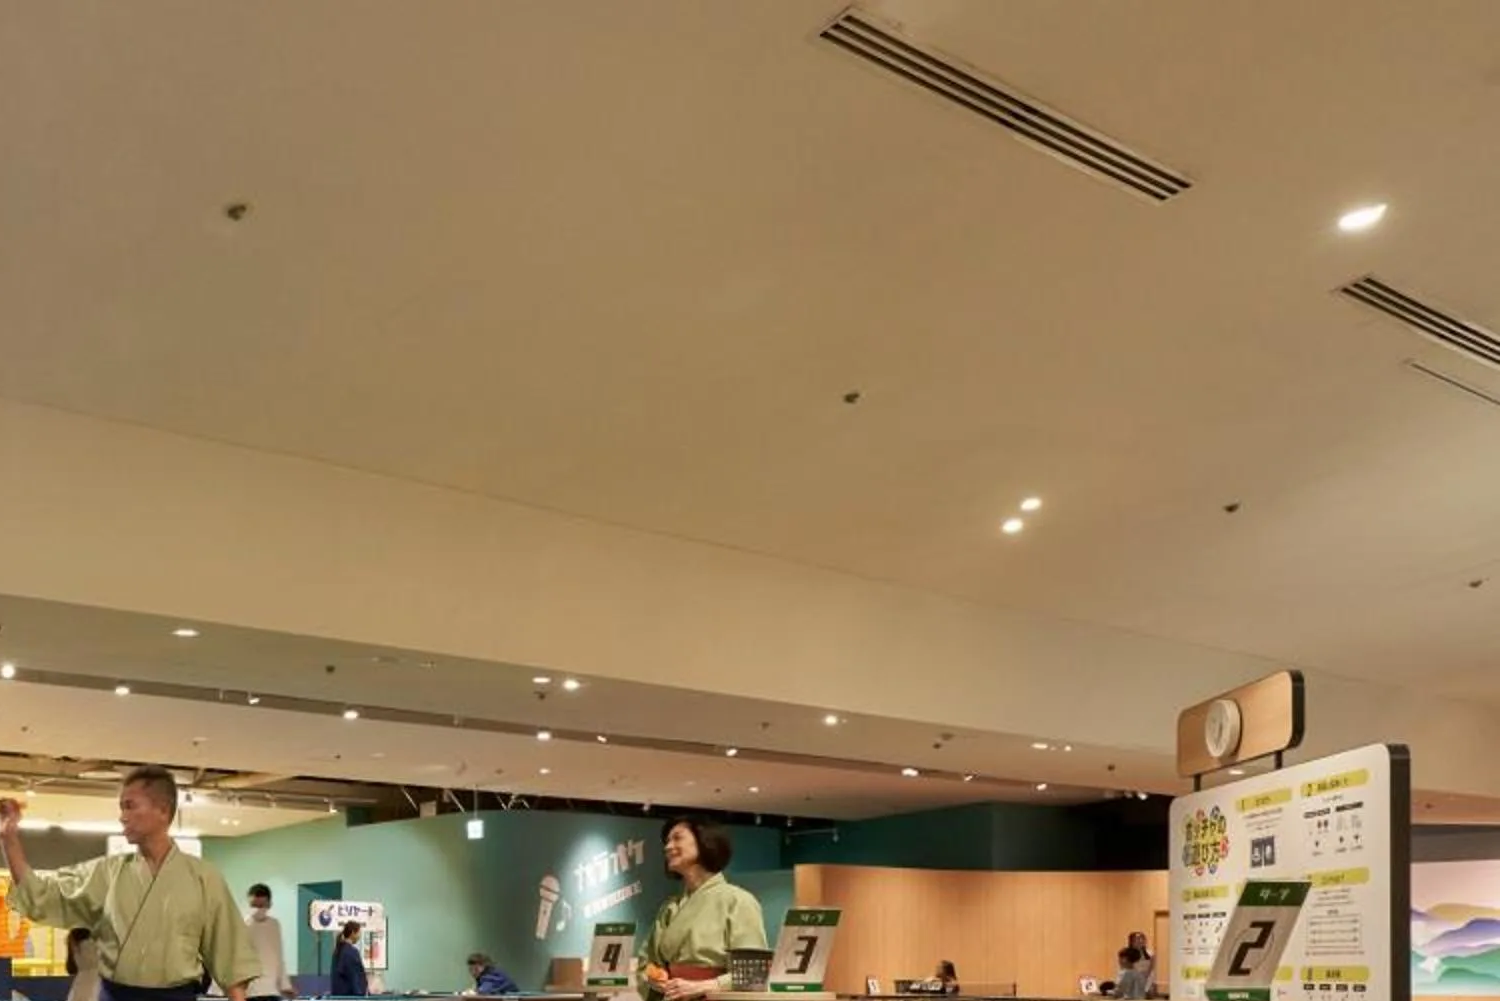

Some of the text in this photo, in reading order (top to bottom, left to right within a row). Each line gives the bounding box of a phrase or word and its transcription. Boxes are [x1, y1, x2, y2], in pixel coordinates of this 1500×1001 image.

[602, 943, 622, 973] 4
[785, 936, 819, 975] 3
[1227, 921, 1277, 977] 2
